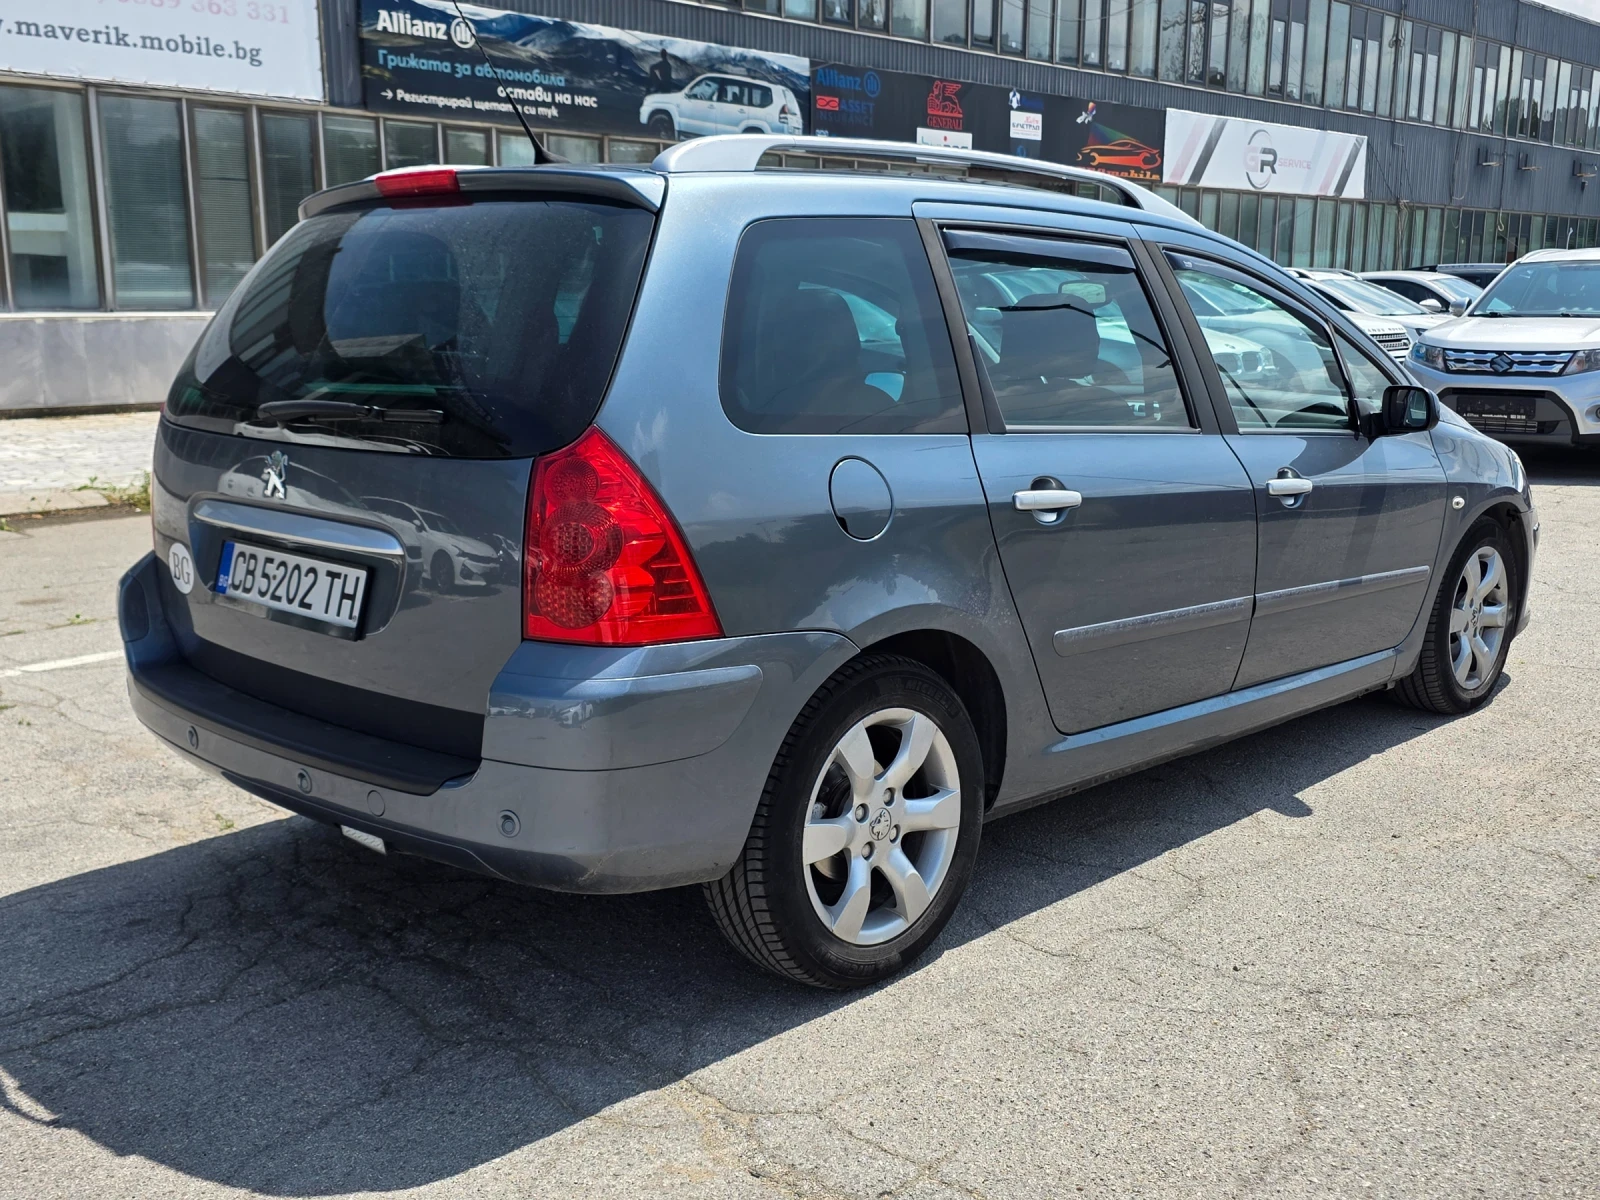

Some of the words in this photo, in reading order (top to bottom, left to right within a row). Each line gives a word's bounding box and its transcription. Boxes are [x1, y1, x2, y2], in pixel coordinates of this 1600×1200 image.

[247, 1, 290, 24] 331
[376, 9, 448, 40] Allianz
[0, 18, 263, 67] .maverik.mobile.bg
[377, 49, 452, 74] Грижата
[453, 62, 472, 78] за
[474, 62, 565, 87] автомобила
[815, 67, 862, 91] Allianz
[395, 88, 472, 109] Регистрирай
[523, 104, 537, 115] си
[537, 104, 559, 118] тук
[497, 85, 553, 103] остави
[554, 93, 573, 105] на
[574, 94, 598, 108] нас
[840, 98, 875, 115] ASSET
[927, 115, 963, 130] GENERALI
[1277, 157, 1312, 170] SERVICE
[172, 551, 191, 585] BG
[218, 574, 229, 588] BG
[257, 557, 318, 611] 5202
[324, 569, 360, 621] TH
